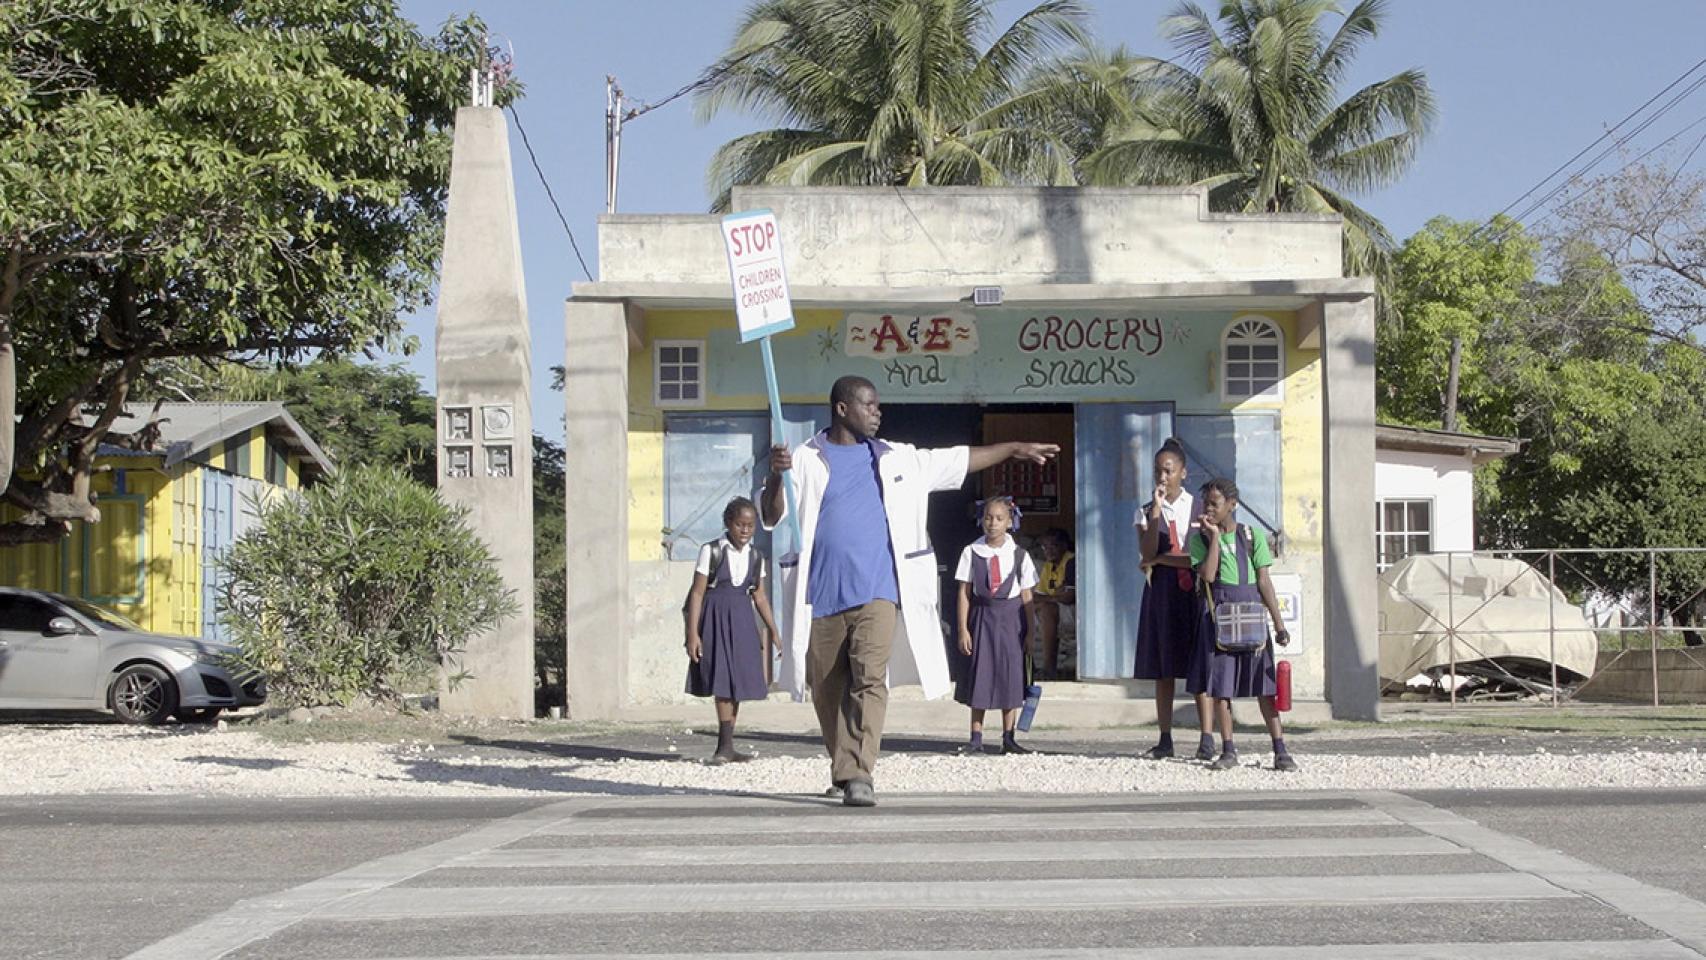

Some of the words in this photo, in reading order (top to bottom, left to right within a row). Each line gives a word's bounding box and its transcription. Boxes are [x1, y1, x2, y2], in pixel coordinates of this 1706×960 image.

[730, 221, 775, 257] STOP
[738, 267, 782, 290] CHILDREN
[741, 285, 785, 309] CROSSING
[1018, 315, 1163, 356] GROCERY
[884, 354, 947, 388] And
